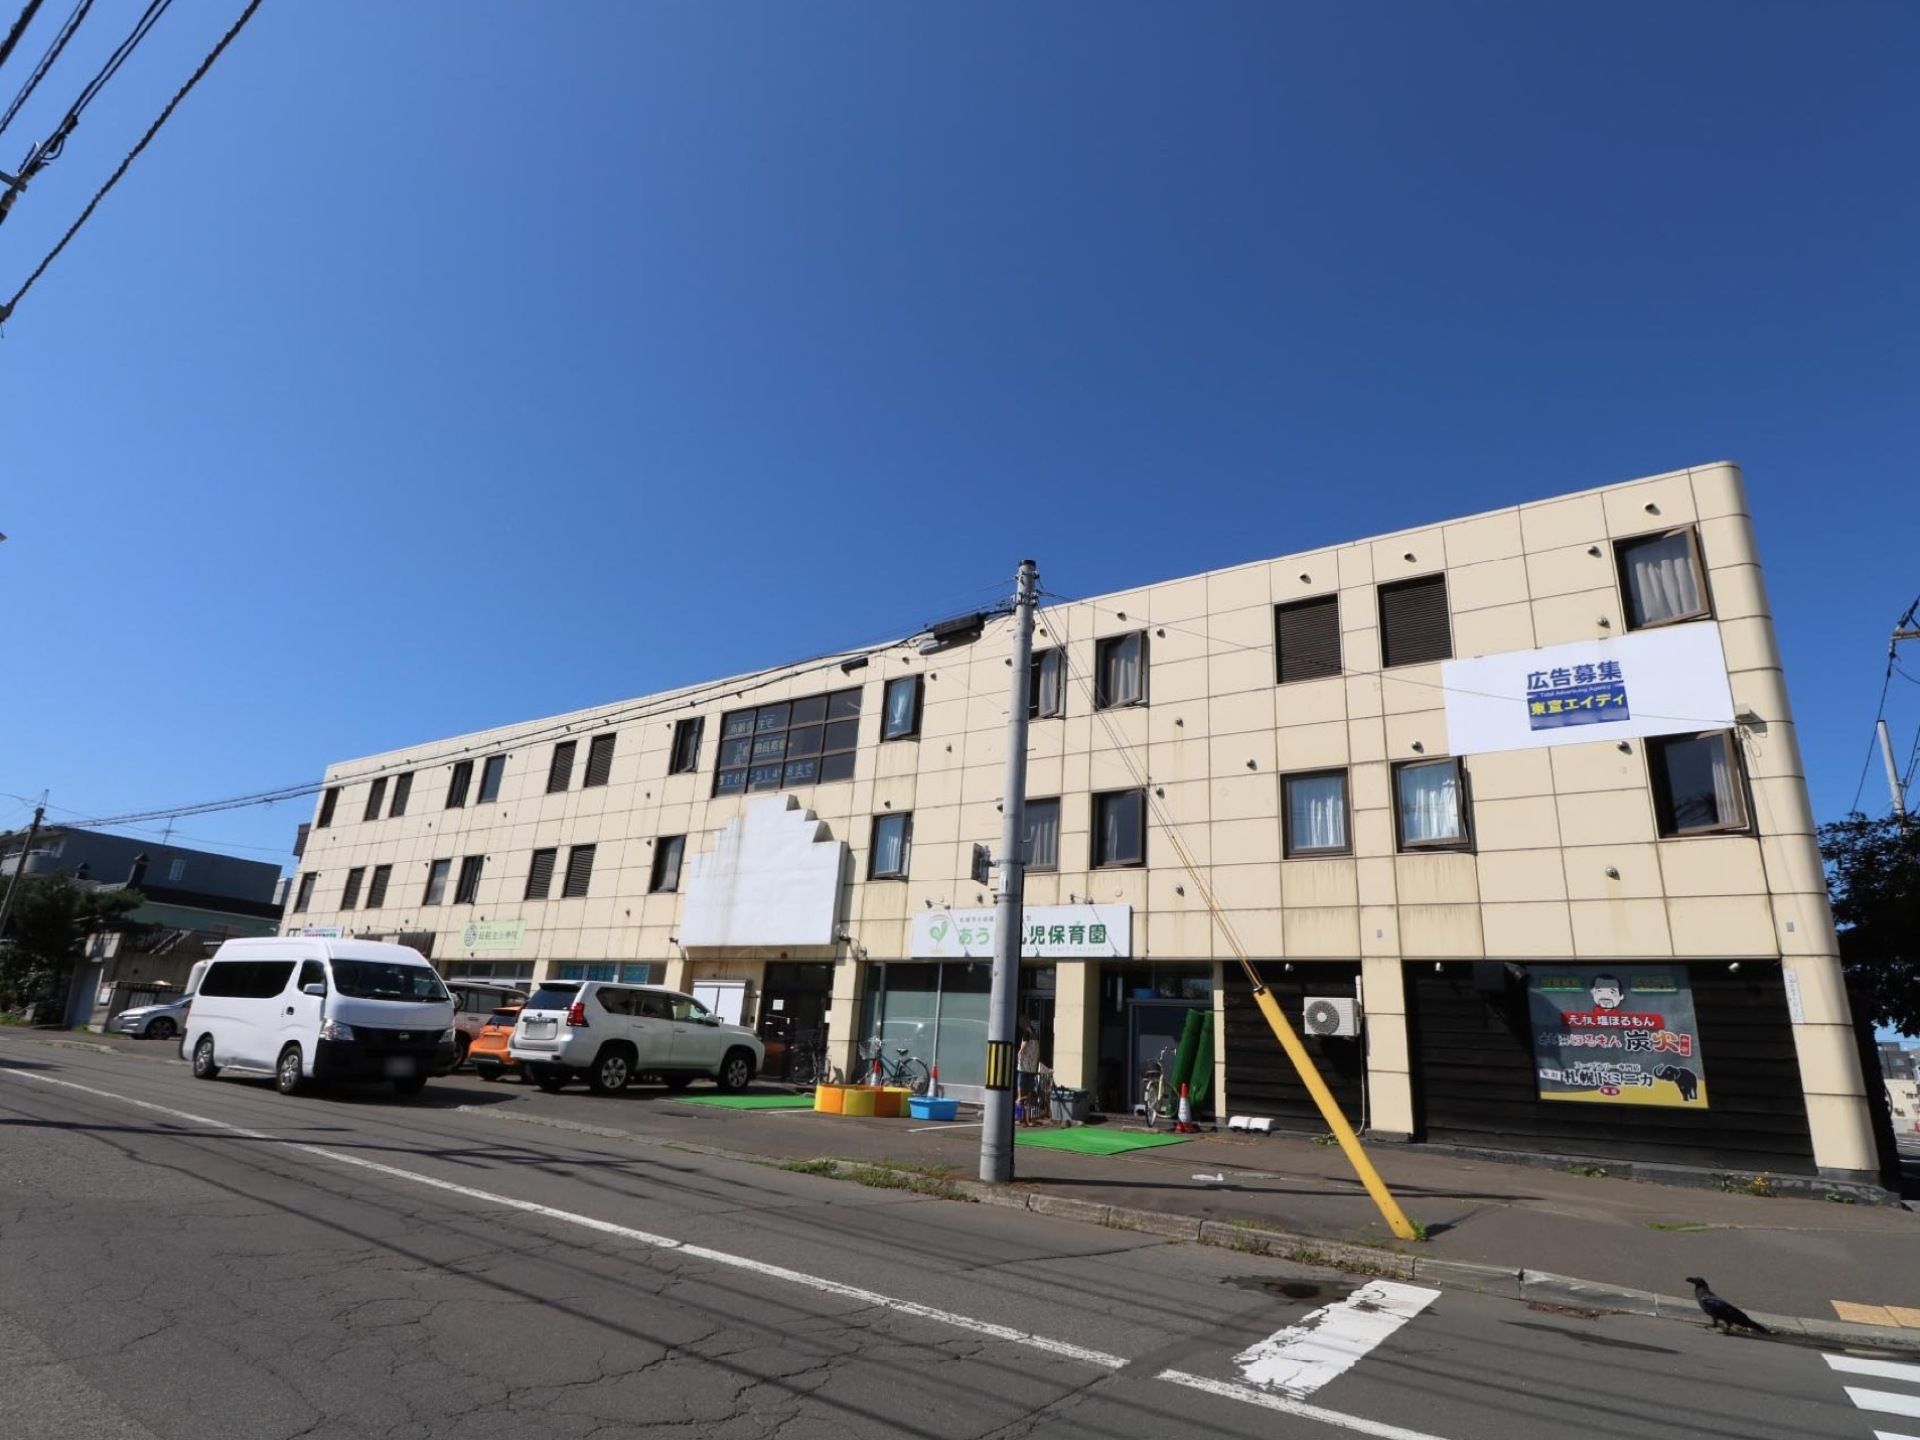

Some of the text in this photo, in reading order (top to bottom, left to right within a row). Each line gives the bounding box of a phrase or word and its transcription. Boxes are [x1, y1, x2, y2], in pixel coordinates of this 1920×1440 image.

[1527, 660, 1622, 690] 広告募集
[1561, 1068, 1655, 1089] 札幌ドミニカ
